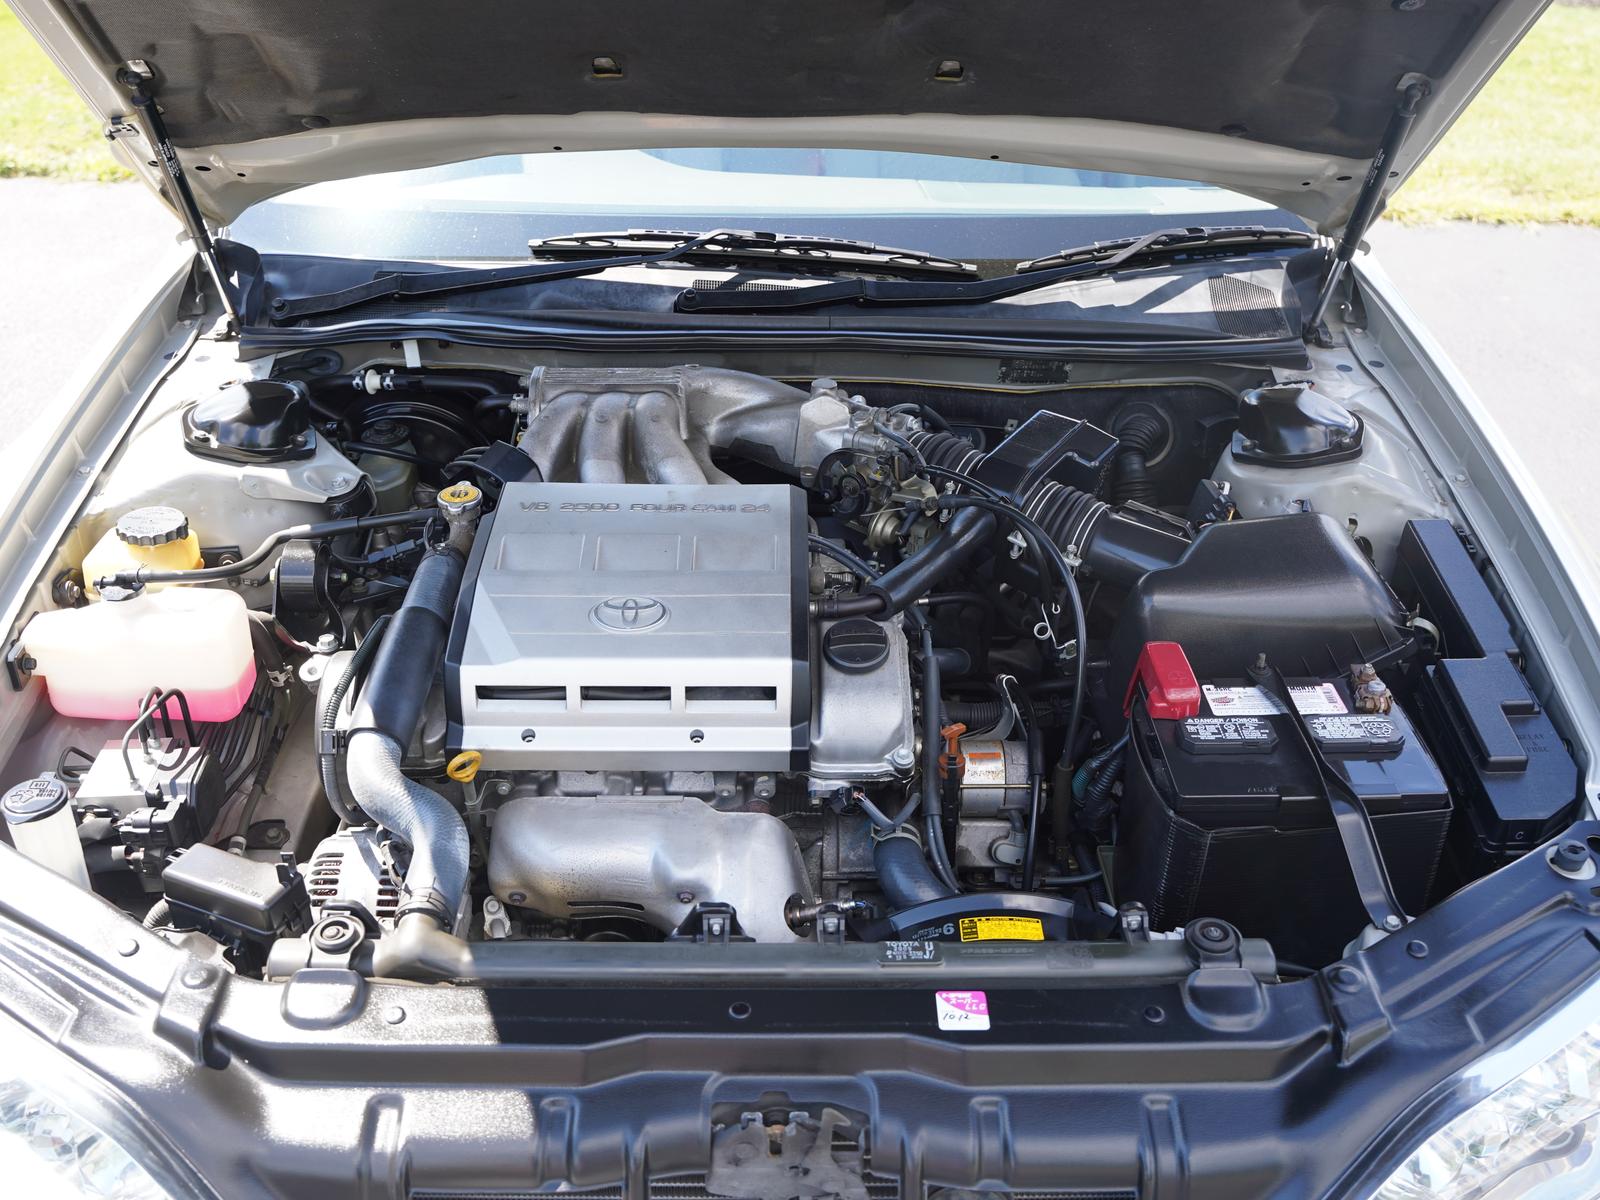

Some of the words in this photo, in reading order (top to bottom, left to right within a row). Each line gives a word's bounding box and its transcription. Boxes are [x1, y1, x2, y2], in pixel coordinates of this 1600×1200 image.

[519, 501, 550, 512] V6
[559, 502, 620, 512] 2500
[629, 503, 687, 513] FOUR
[691, 503, 736, 513] CAM
[740, 503, 772, 513] 24
[942, 923, 955, 935] 6
